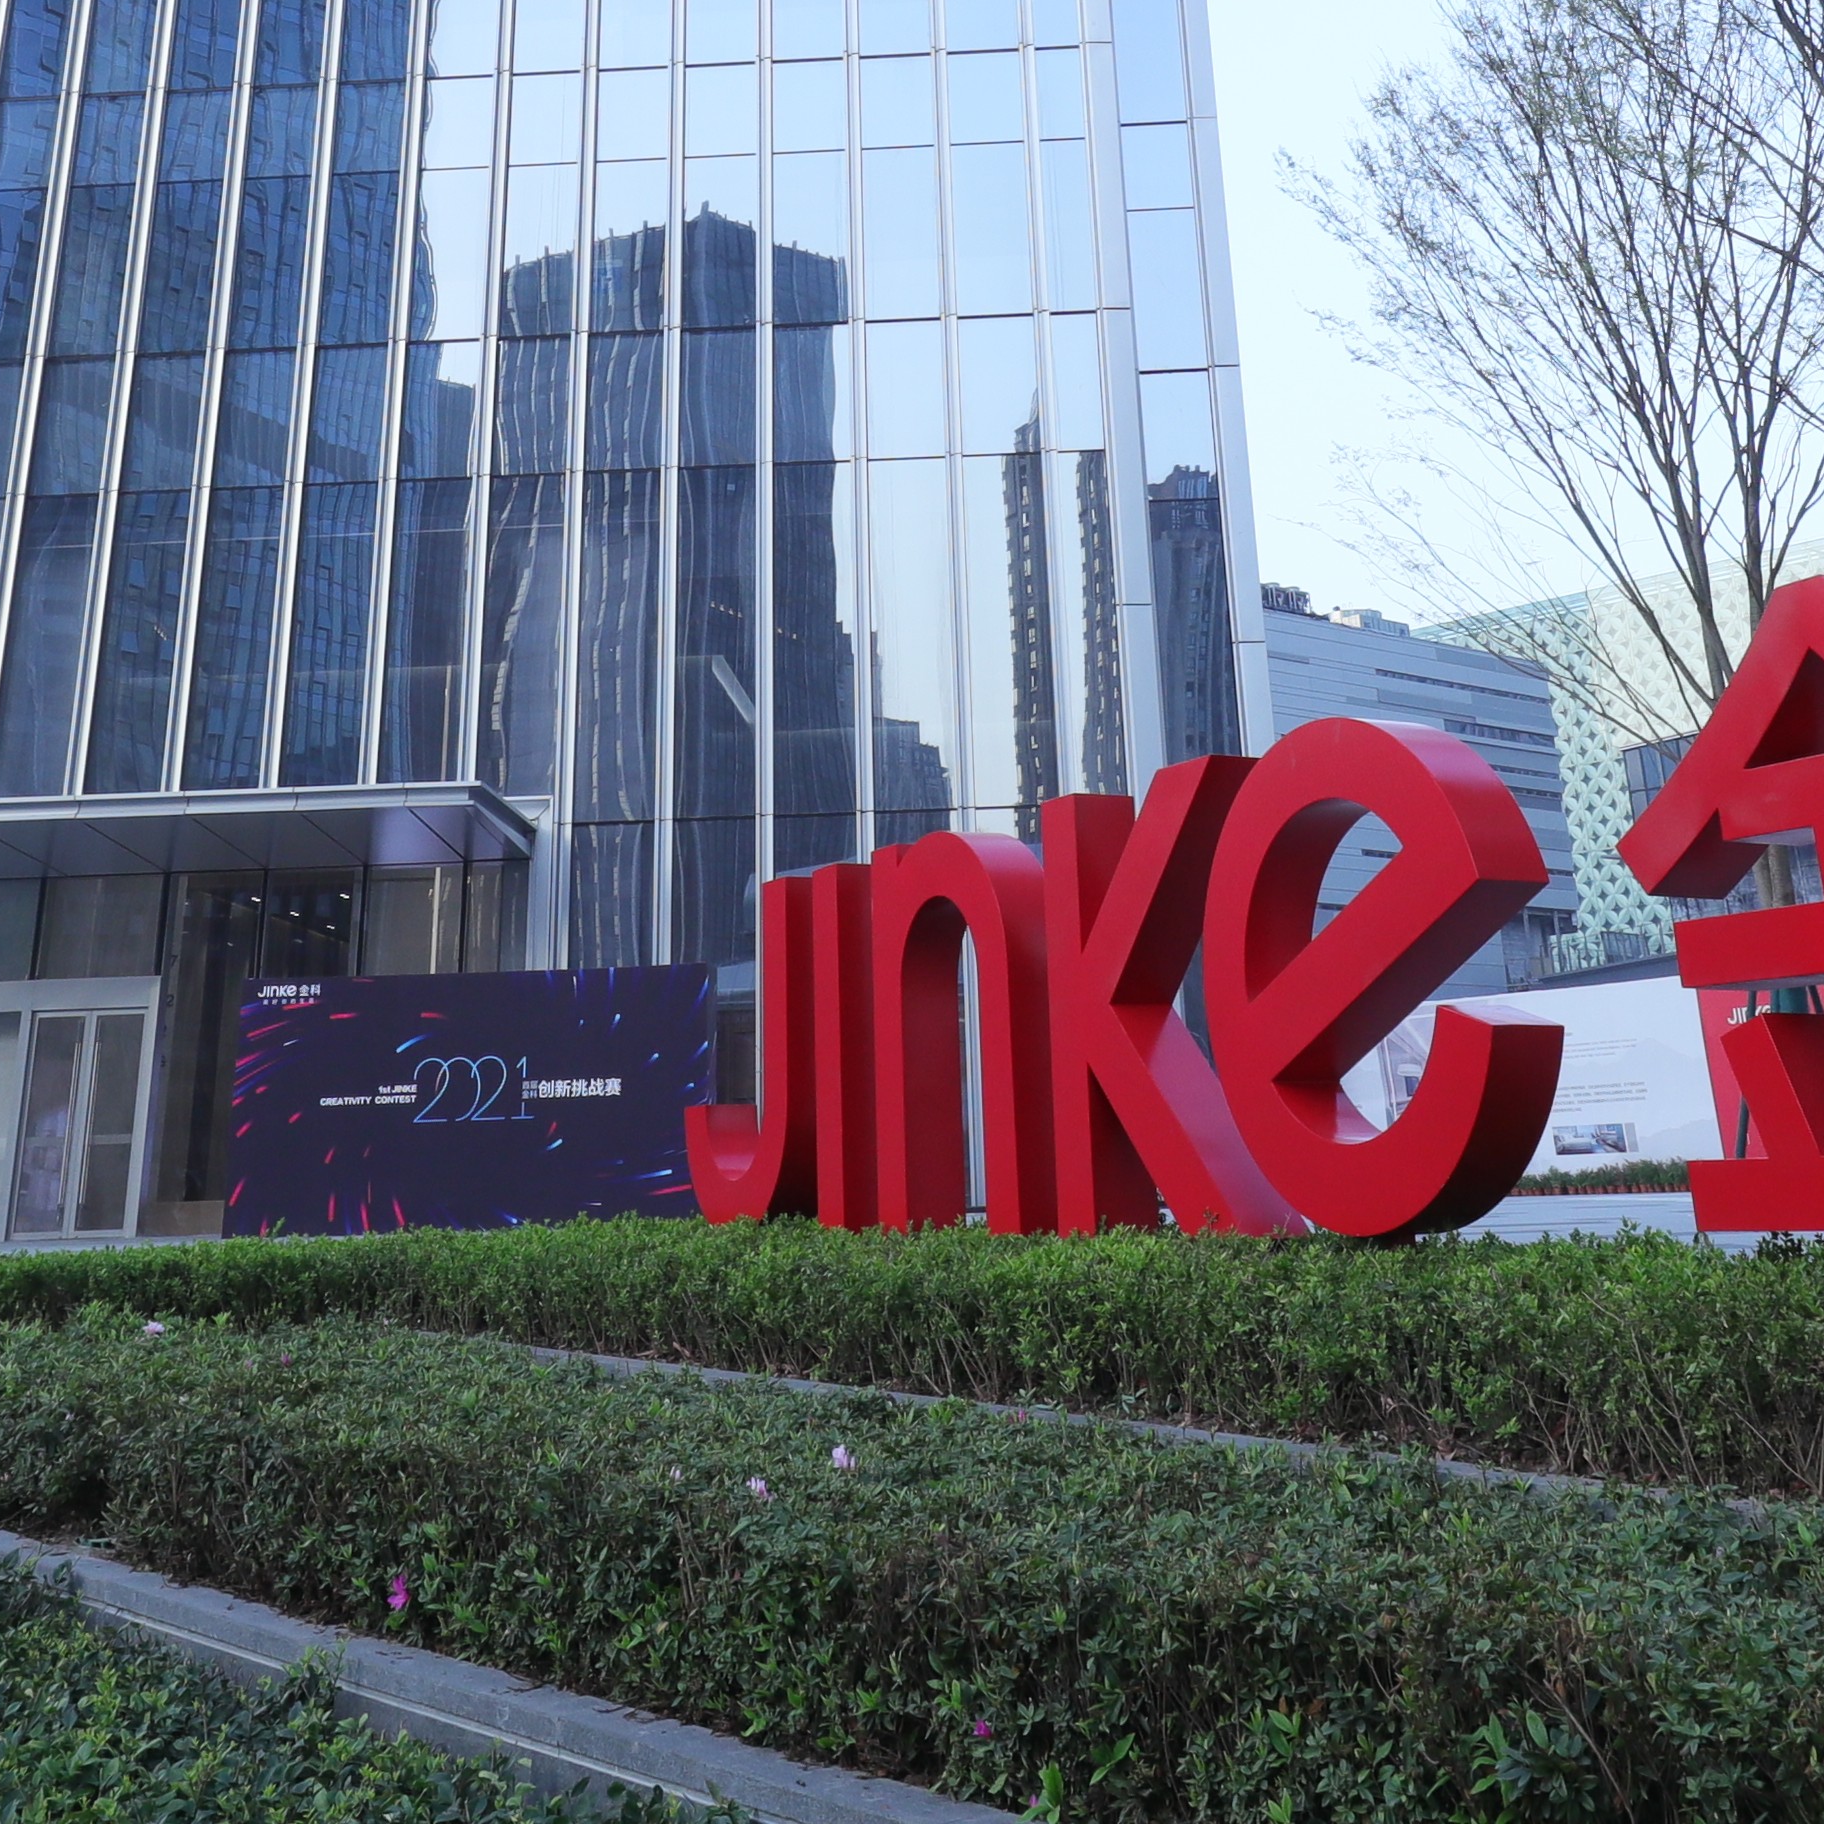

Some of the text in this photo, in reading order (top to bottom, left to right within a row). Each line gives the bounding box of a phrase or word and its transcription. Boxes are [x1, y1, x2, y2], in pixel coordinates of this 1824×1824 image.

[299, 983, 321, 997] 金科
[538, 1077, 622, 1099] 创新挑战赛
[319, 1094, 418, 1107] CREATIVITY CONTEST
